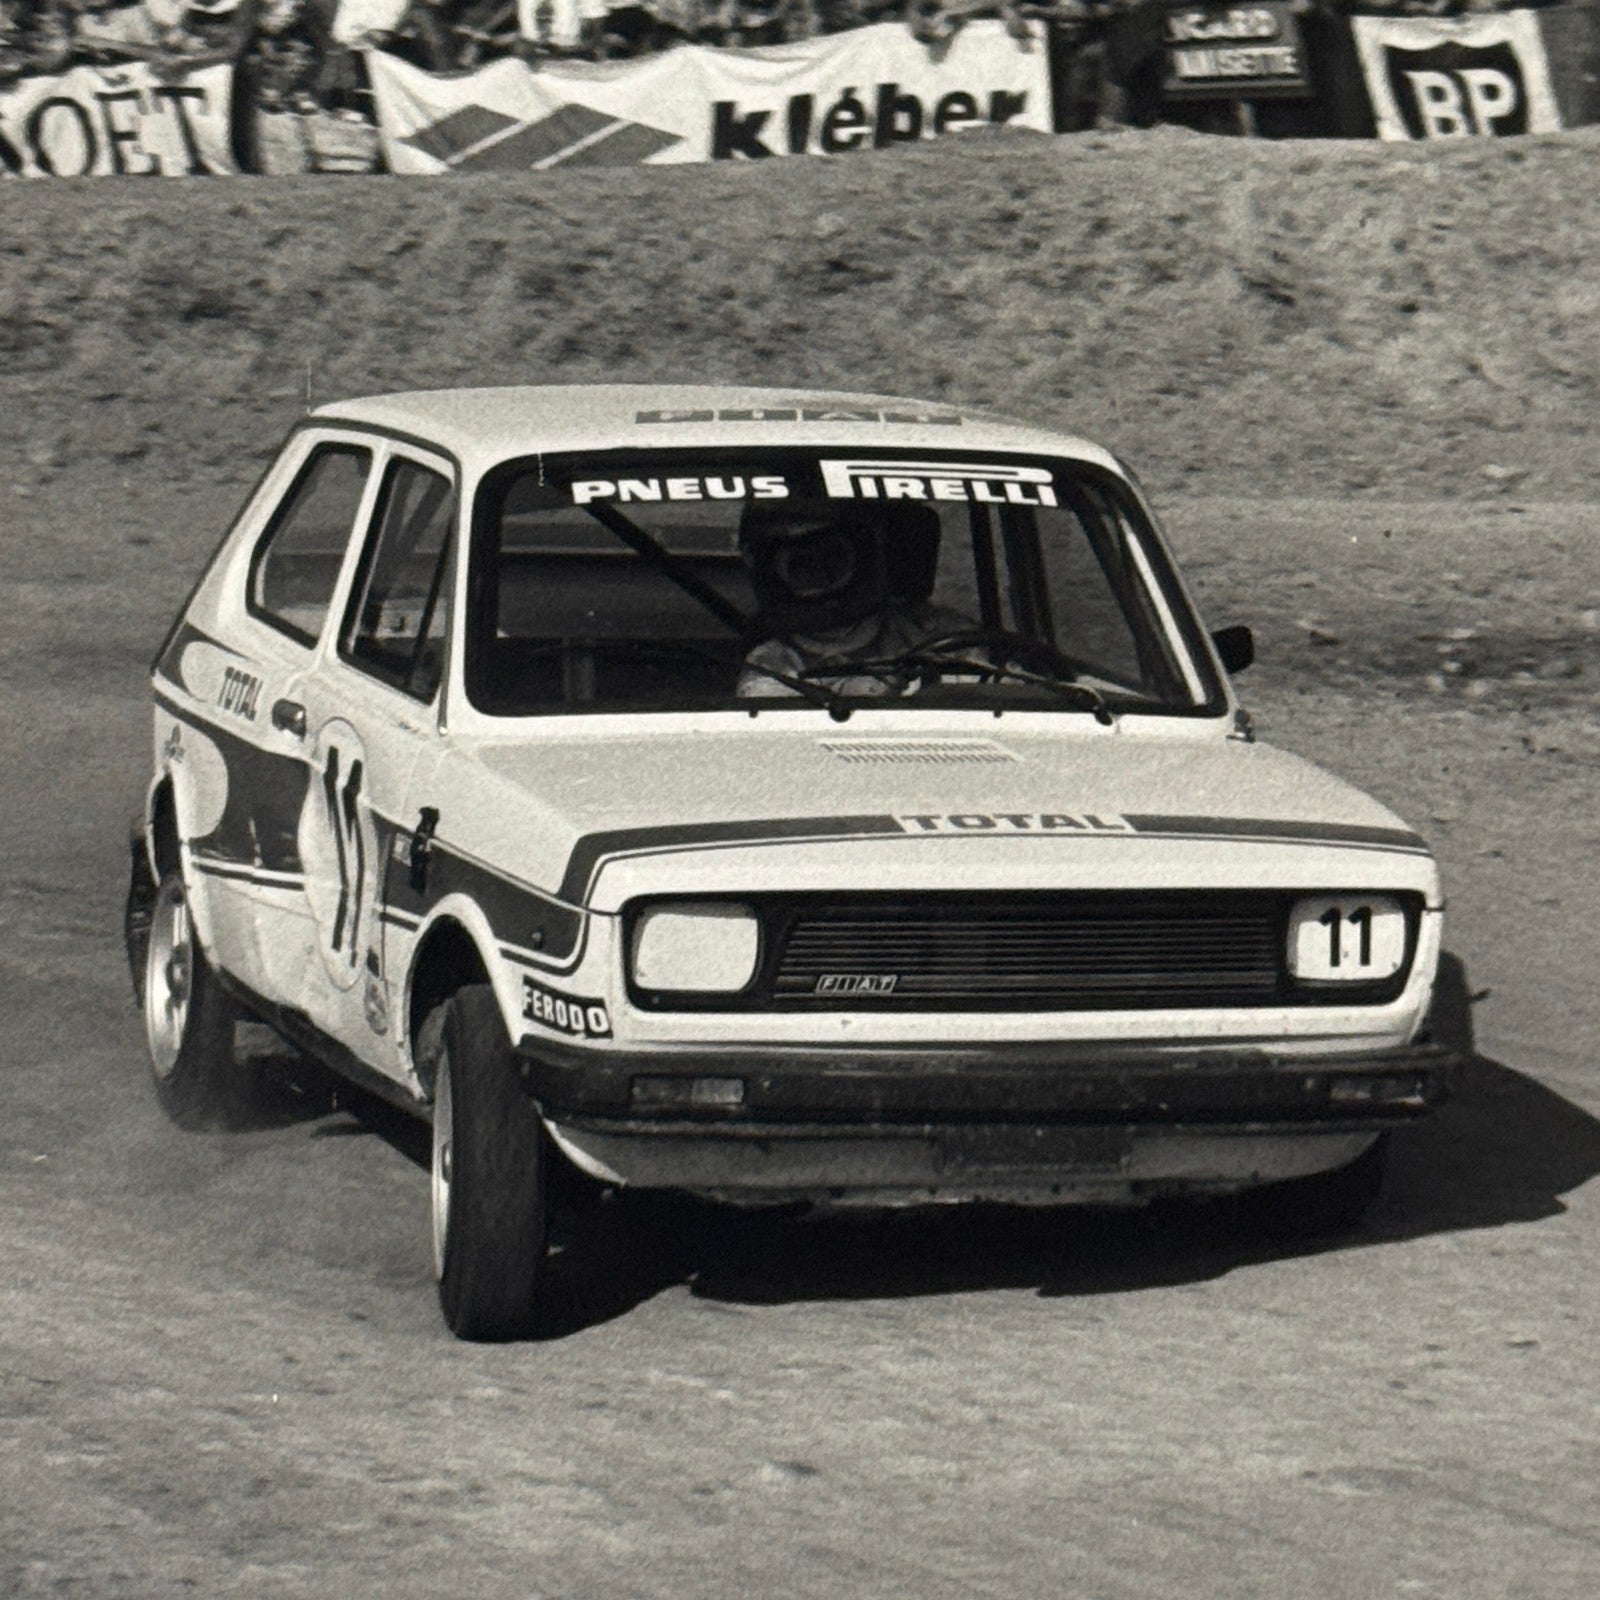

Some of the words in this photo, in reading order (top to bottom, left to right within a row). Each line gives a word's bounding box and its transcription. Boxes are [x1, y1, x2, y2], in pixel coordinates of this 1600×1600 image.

[1403, 69, 1514, 138] BP
[571, 476, 790, 505] PNEUS
[819, 460, 1058, 507] PIRELLI
[217, 666, 263, 721] TOTAL
[901, 814, 1125, 830] TOTAL
[1318, 906, 1372, 967] 11
[818, 975, 895, 993] FIAT
[522, 985, 610, 1033] FERODO
